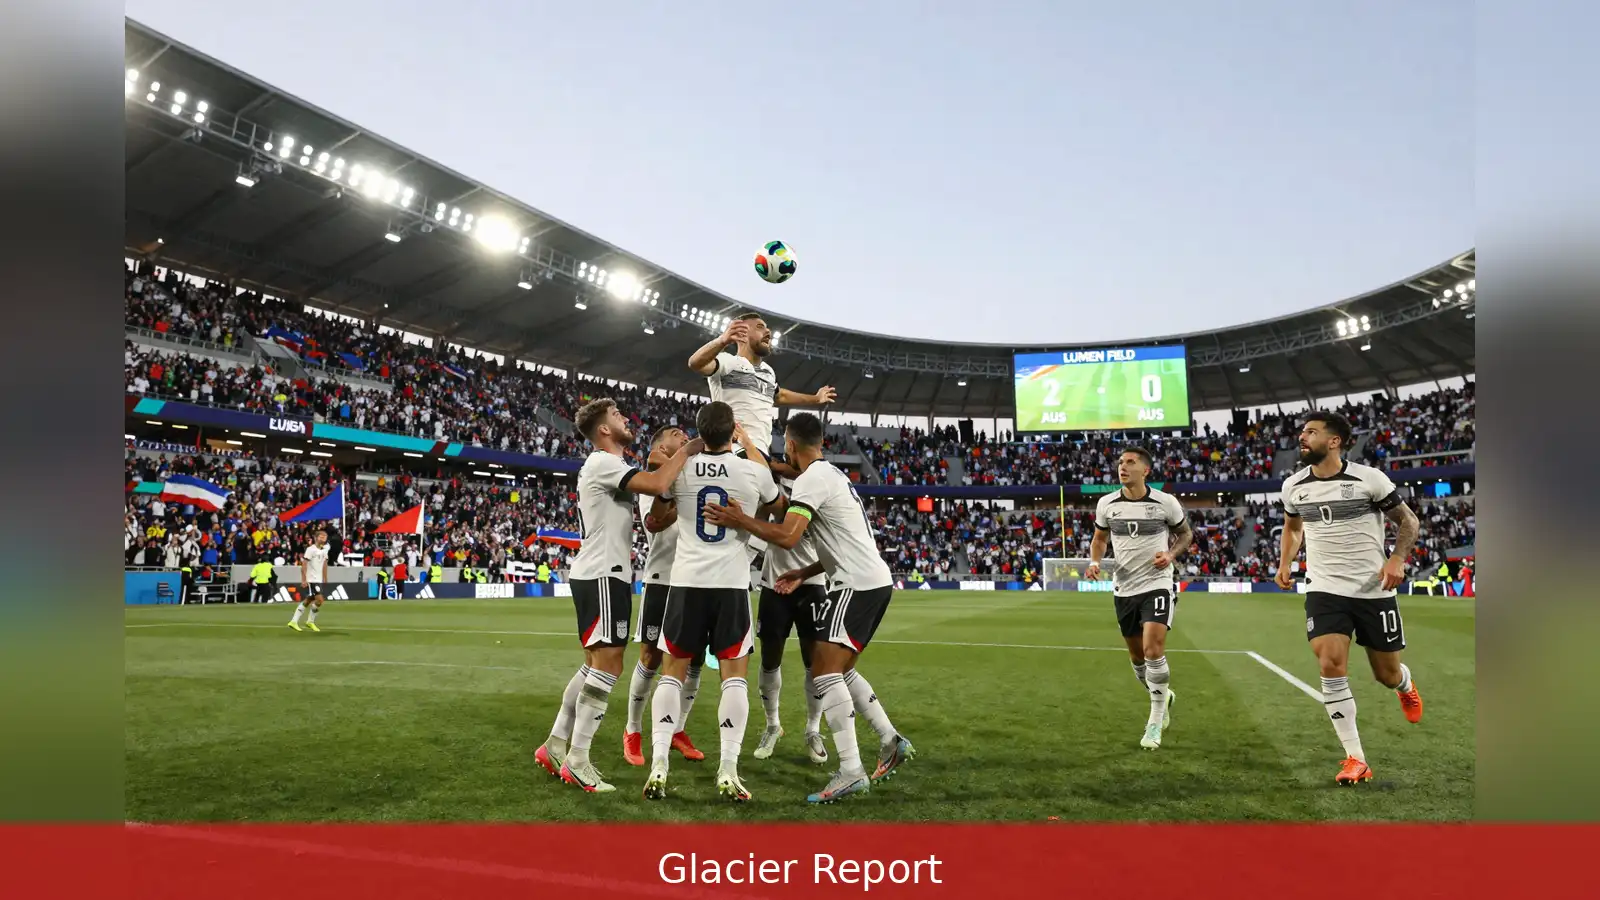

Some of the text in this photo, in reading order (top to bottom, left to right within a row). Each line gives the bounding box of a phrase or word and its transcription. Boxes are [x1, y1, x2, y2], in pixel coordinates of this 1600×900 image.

[1063, 350, 1104, 363] LUMEN
[1042, 374, 1162, 406] 2 0
[1041, 407, 1165, 424] AUS AUS
[695, 462, 729, 478] USA
[1379, 610, 1398, 633] 10
